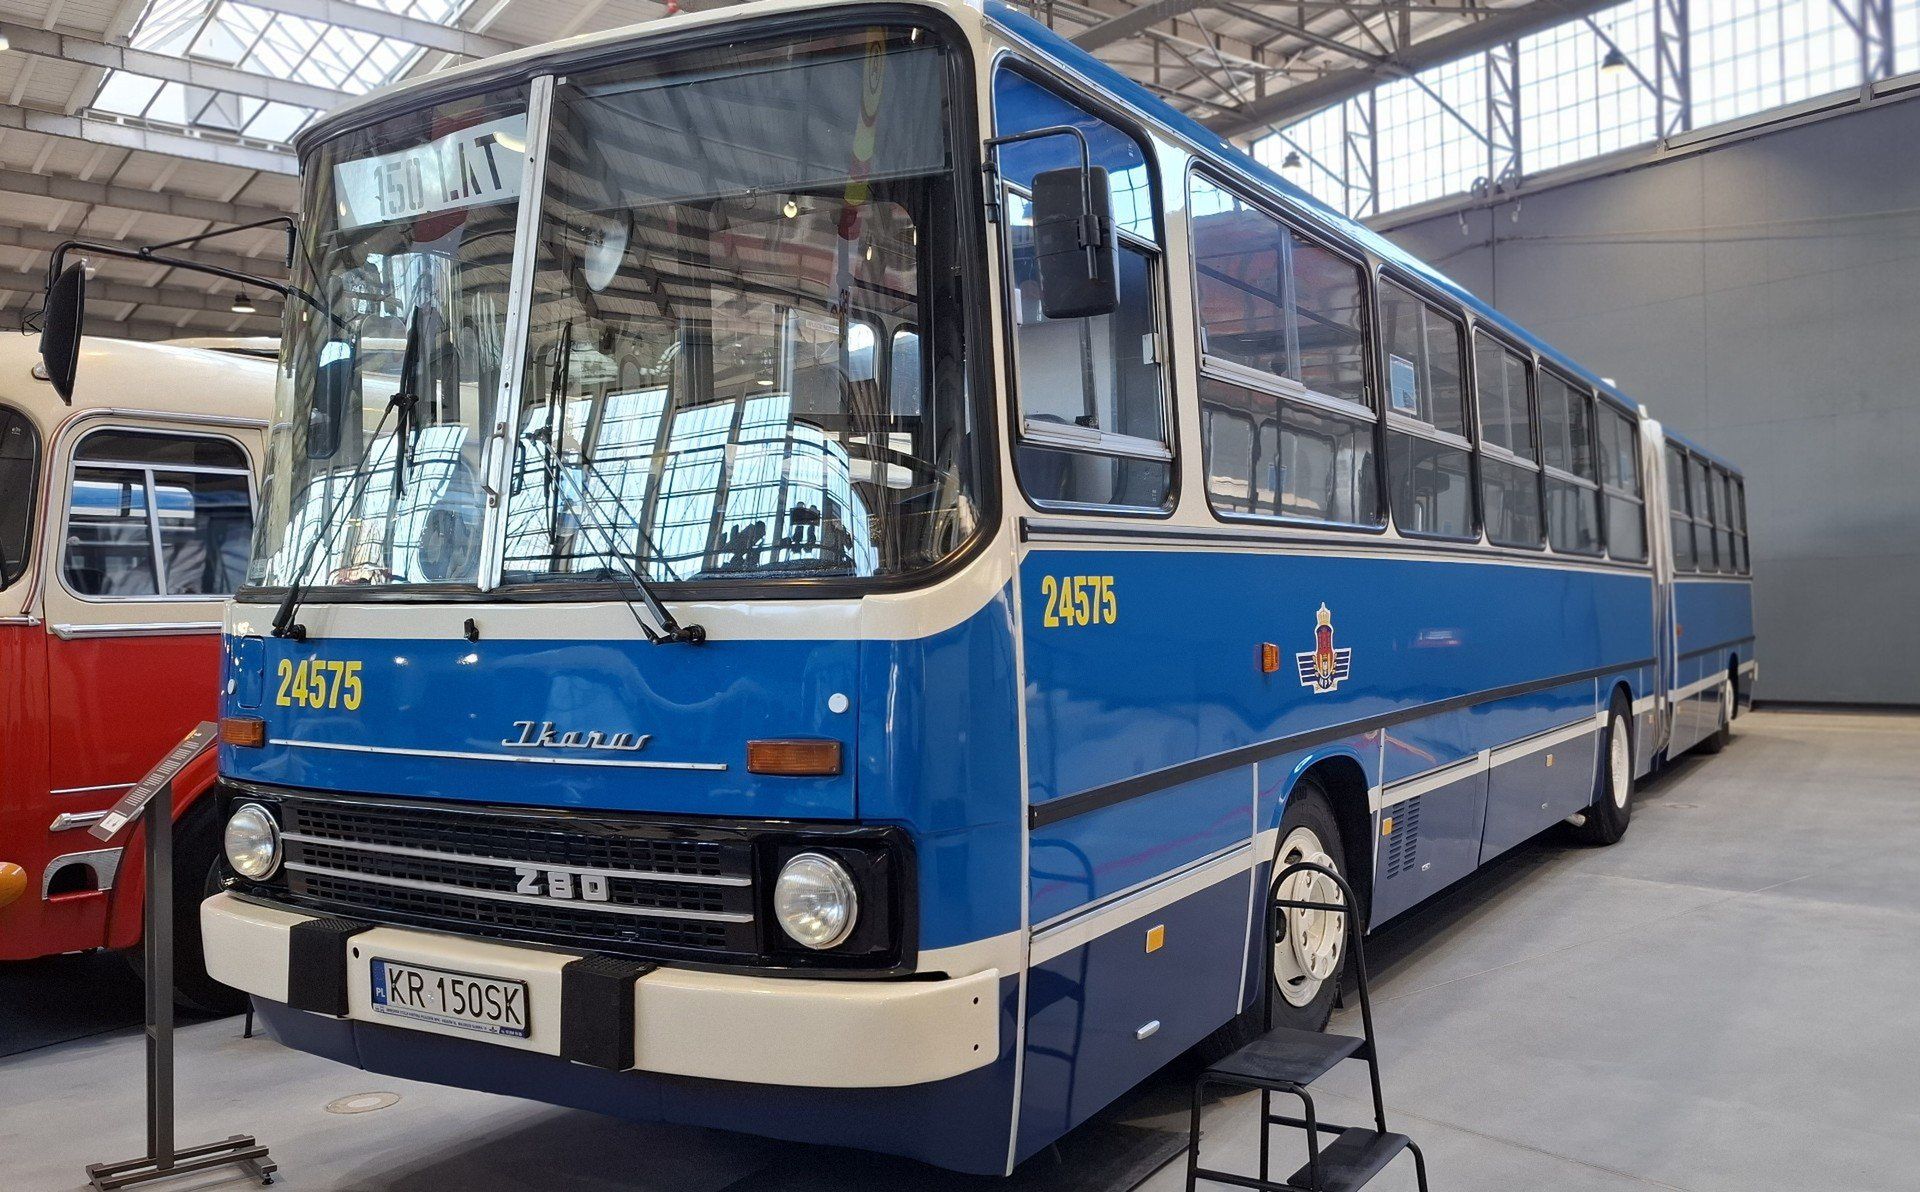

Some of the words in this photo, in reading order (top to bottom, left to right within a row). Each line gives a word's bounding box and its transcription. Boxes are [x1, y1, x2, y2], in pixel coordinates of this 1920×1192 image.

[374, 157, 425, 217] 150
[436, 132, 502, 203] LAT
[1041, 575, 1117, 628] 24575
[276, 658, 362, 711] 24575
[501, 720, 651, 751] Ikarus
[375, 987, 386, 998] PL
[388, 967, 426, 1009] KR
[436, 976, 522, 1026] 150SK
